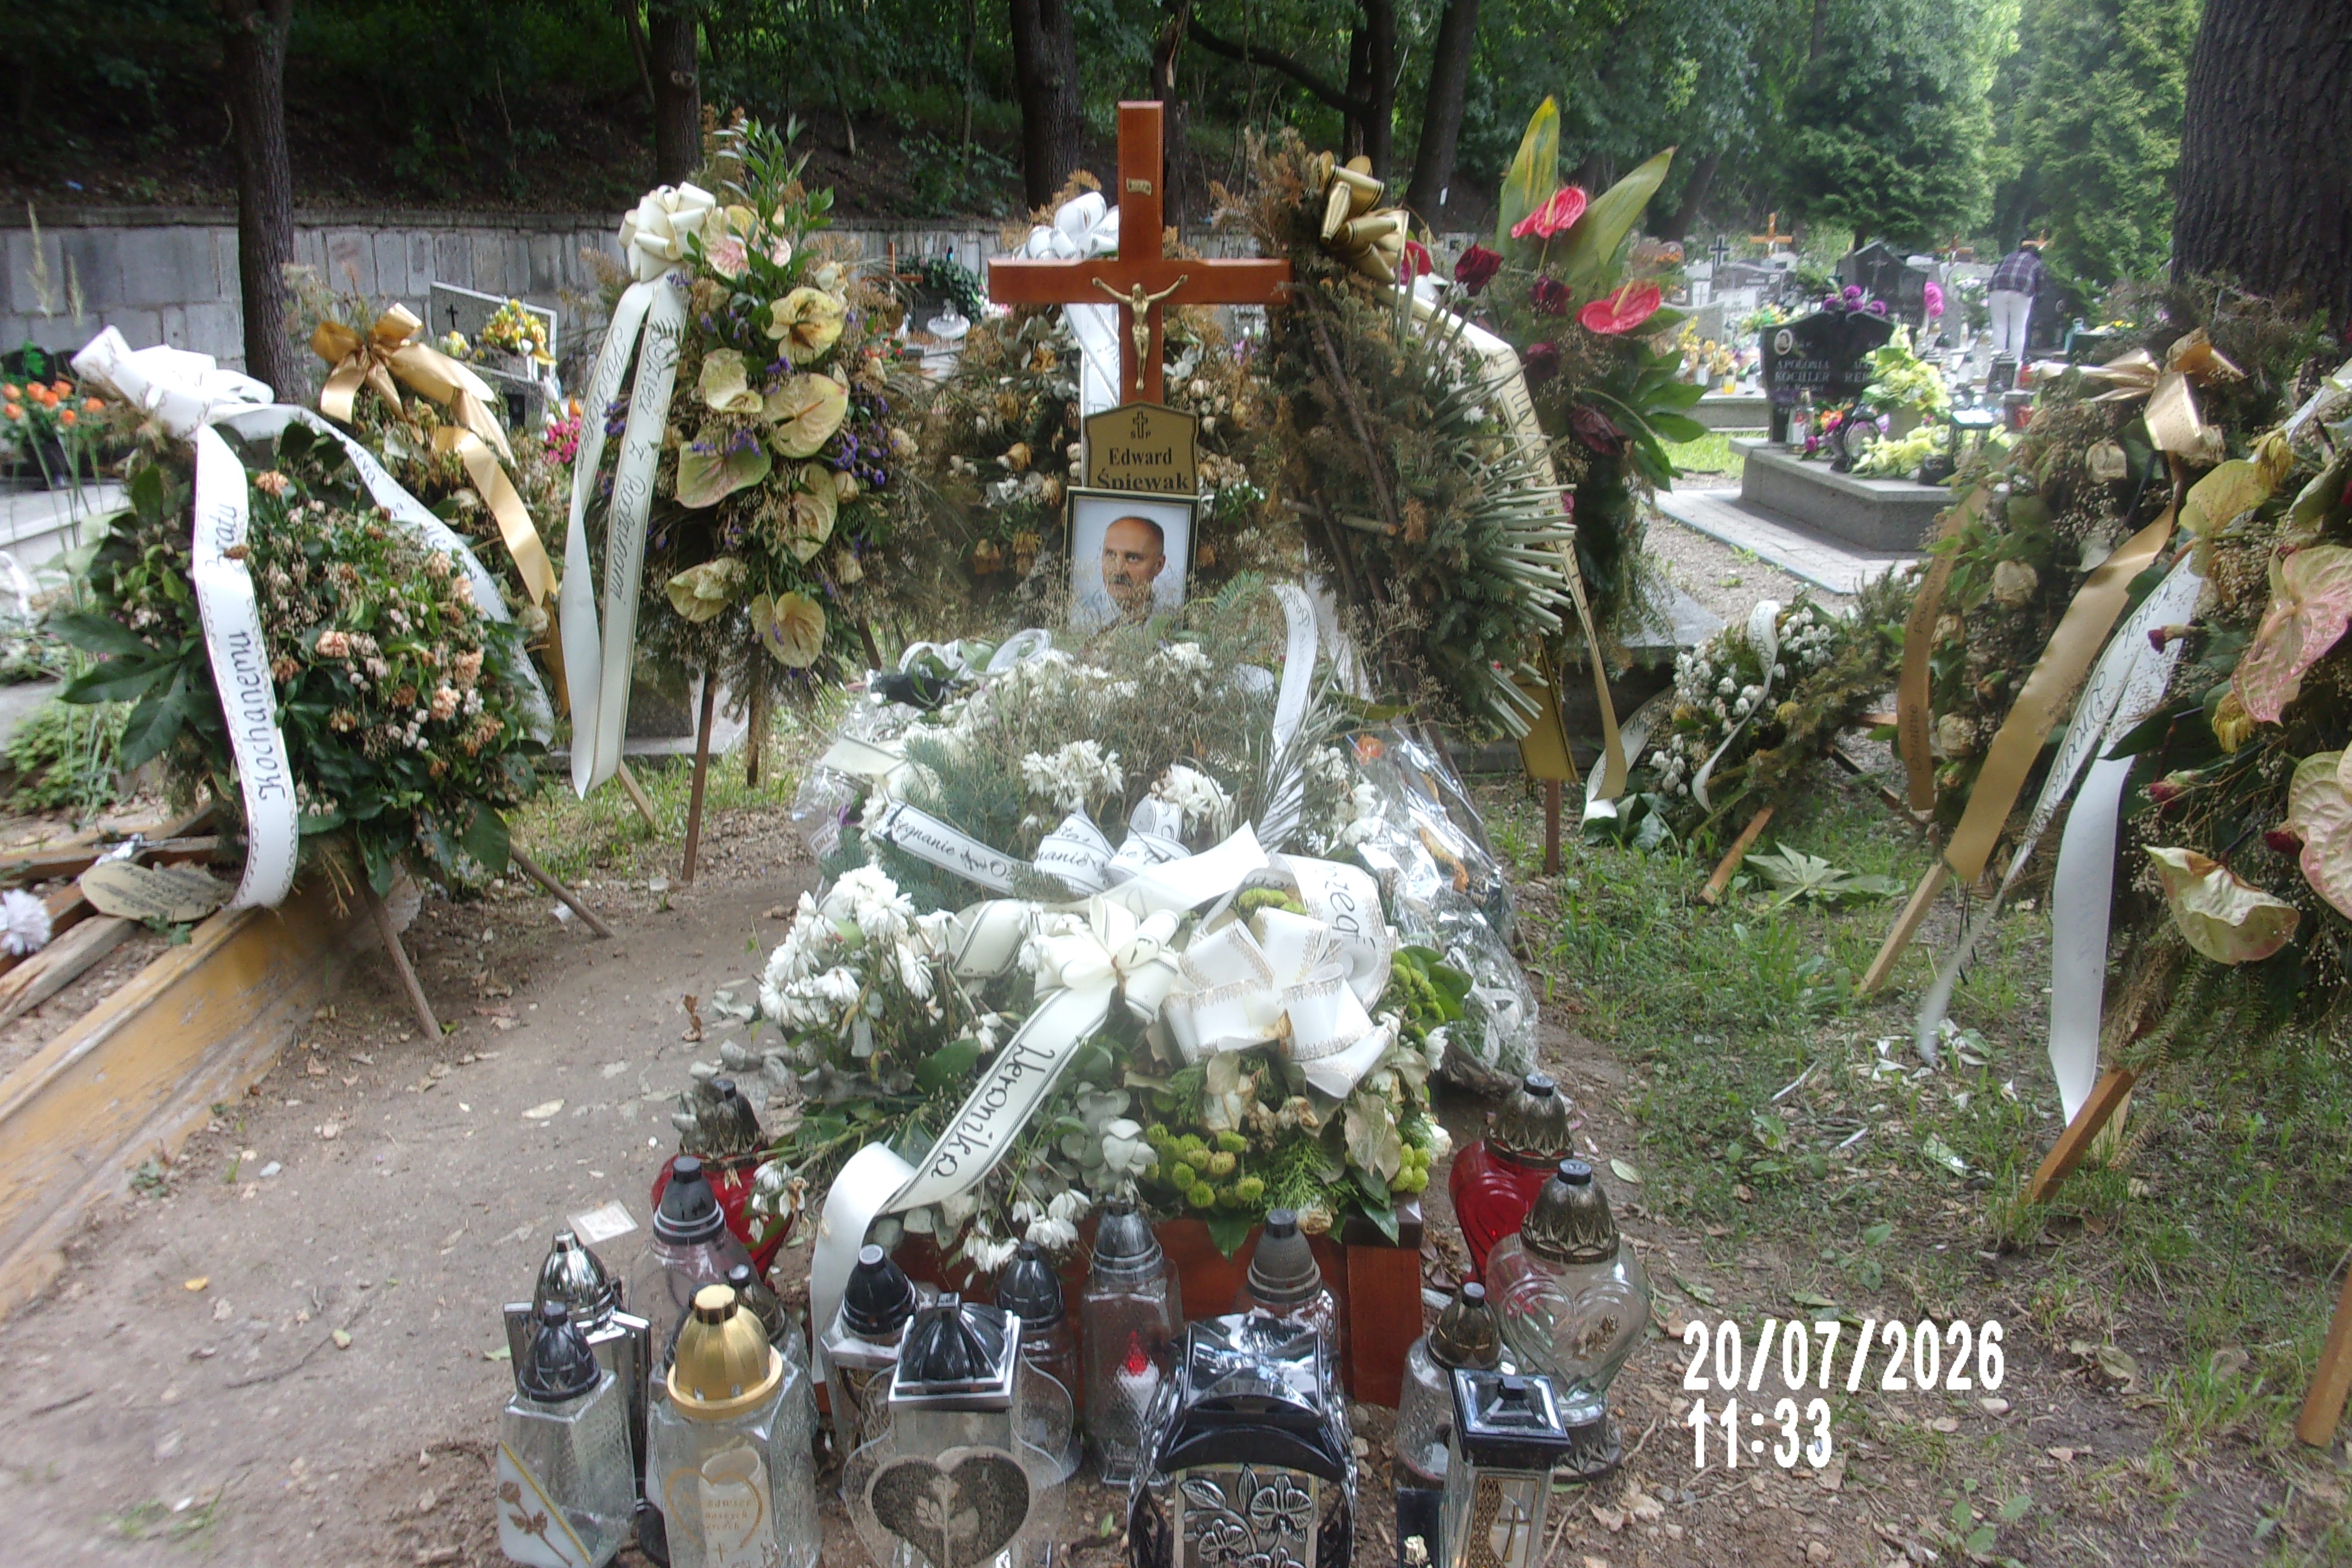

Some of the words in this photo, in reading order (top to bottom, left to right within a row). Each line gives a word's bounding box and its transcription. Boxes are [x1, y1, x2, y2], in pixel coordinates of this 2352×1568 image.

[577, 326, 626, 472] Kochanem
[1109, 447, 1172, 465] Edward
[1097, 467, 1188, 490] Śpiewak
[229, 630, 285, 800] Kochanemu
[932, 1043, 1055, 1178] Weronika
